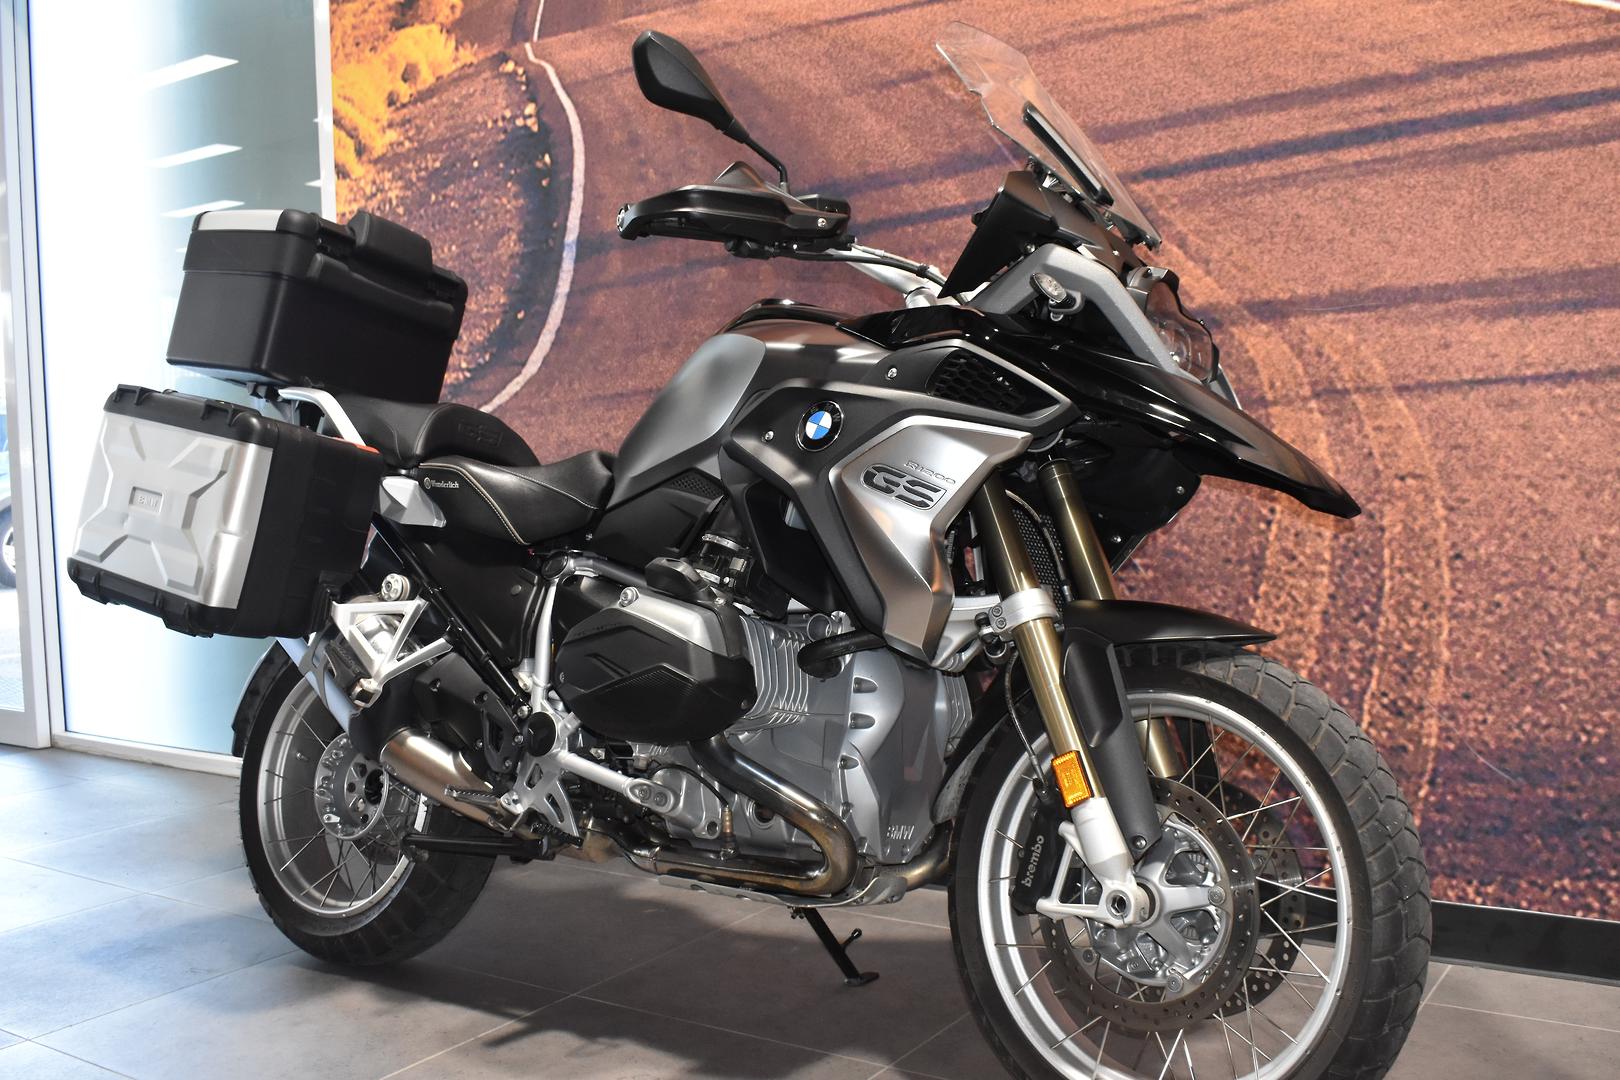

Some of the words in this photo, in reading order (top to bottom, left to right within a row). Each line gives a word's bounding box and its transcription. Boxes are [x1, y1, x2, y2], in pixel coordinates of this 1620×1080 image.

[863, 466, 941, 508] GS
[887, 825, 914, 840] BMW
[1021, 835, 1045, 887] brembo
